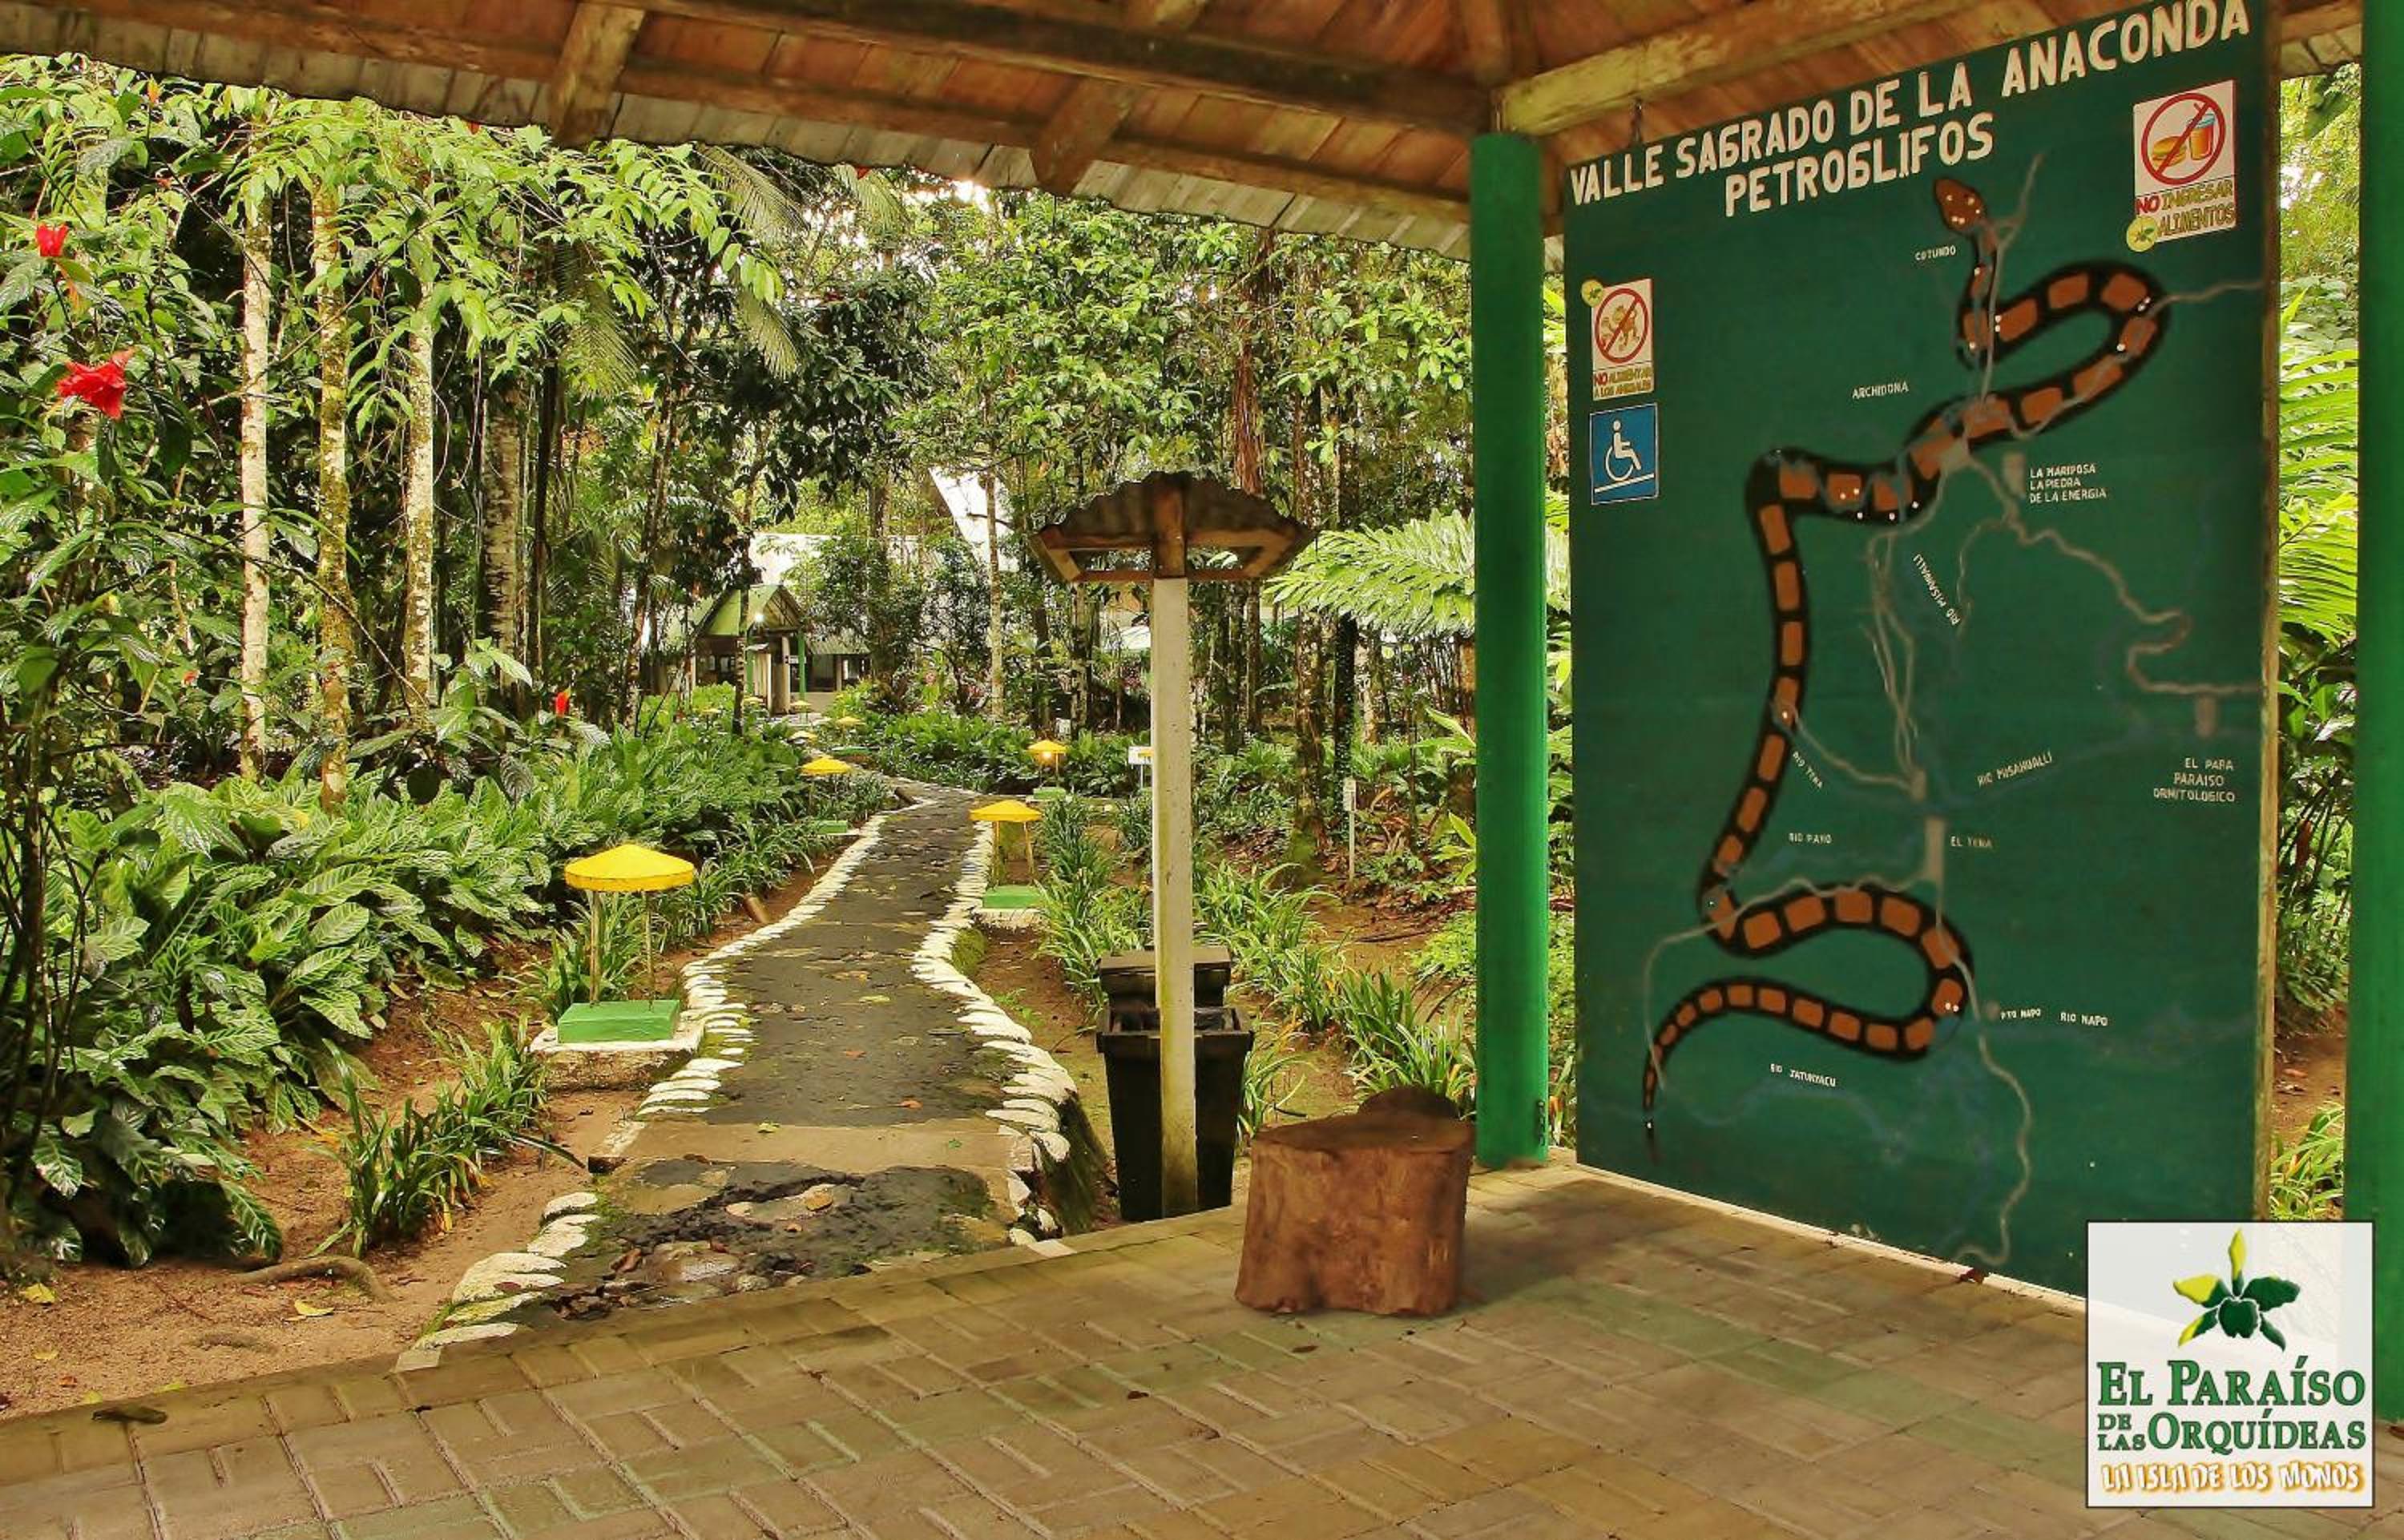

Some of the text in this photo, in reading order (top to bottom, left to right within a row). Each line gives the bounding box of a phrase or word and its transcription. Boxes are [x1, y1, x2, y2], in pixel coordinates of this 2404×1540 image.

[1570, 0, 2251, 206] VALLE SAGRADO DE LA ANACONDA
[1724, 111, 1995, 218] PETROGLIFOS
[2135, 179, 2233, 216] NO INGRESAR
[2156, 203, 2235, 237] ALIMENTOS
[1915, 244, 1956, 260] COTUNDO
[1594, 371, 1607, 387] NO
[1852, 381, 1910, 400] ARCHIDONA
[2030, 463, 2096, 478] LA MARIPOSA
[2030, 478, 2081, 490] LA PIEDRA
[2030, 488, 2107, 504] DE LA ENERGIA
[1946, 608, 1961, 626] RIO
[1793, 752, 1805, 767] RIO
[2184, 757, 2199, 768] EL
[2173, 772, 2225, 787] PARAISO
[1950, 836, 1963, 847] EL
[2020, 1008, 2042, 1018] NAPO
[2060, 1012, 2109, 1026] RIO NAPO
